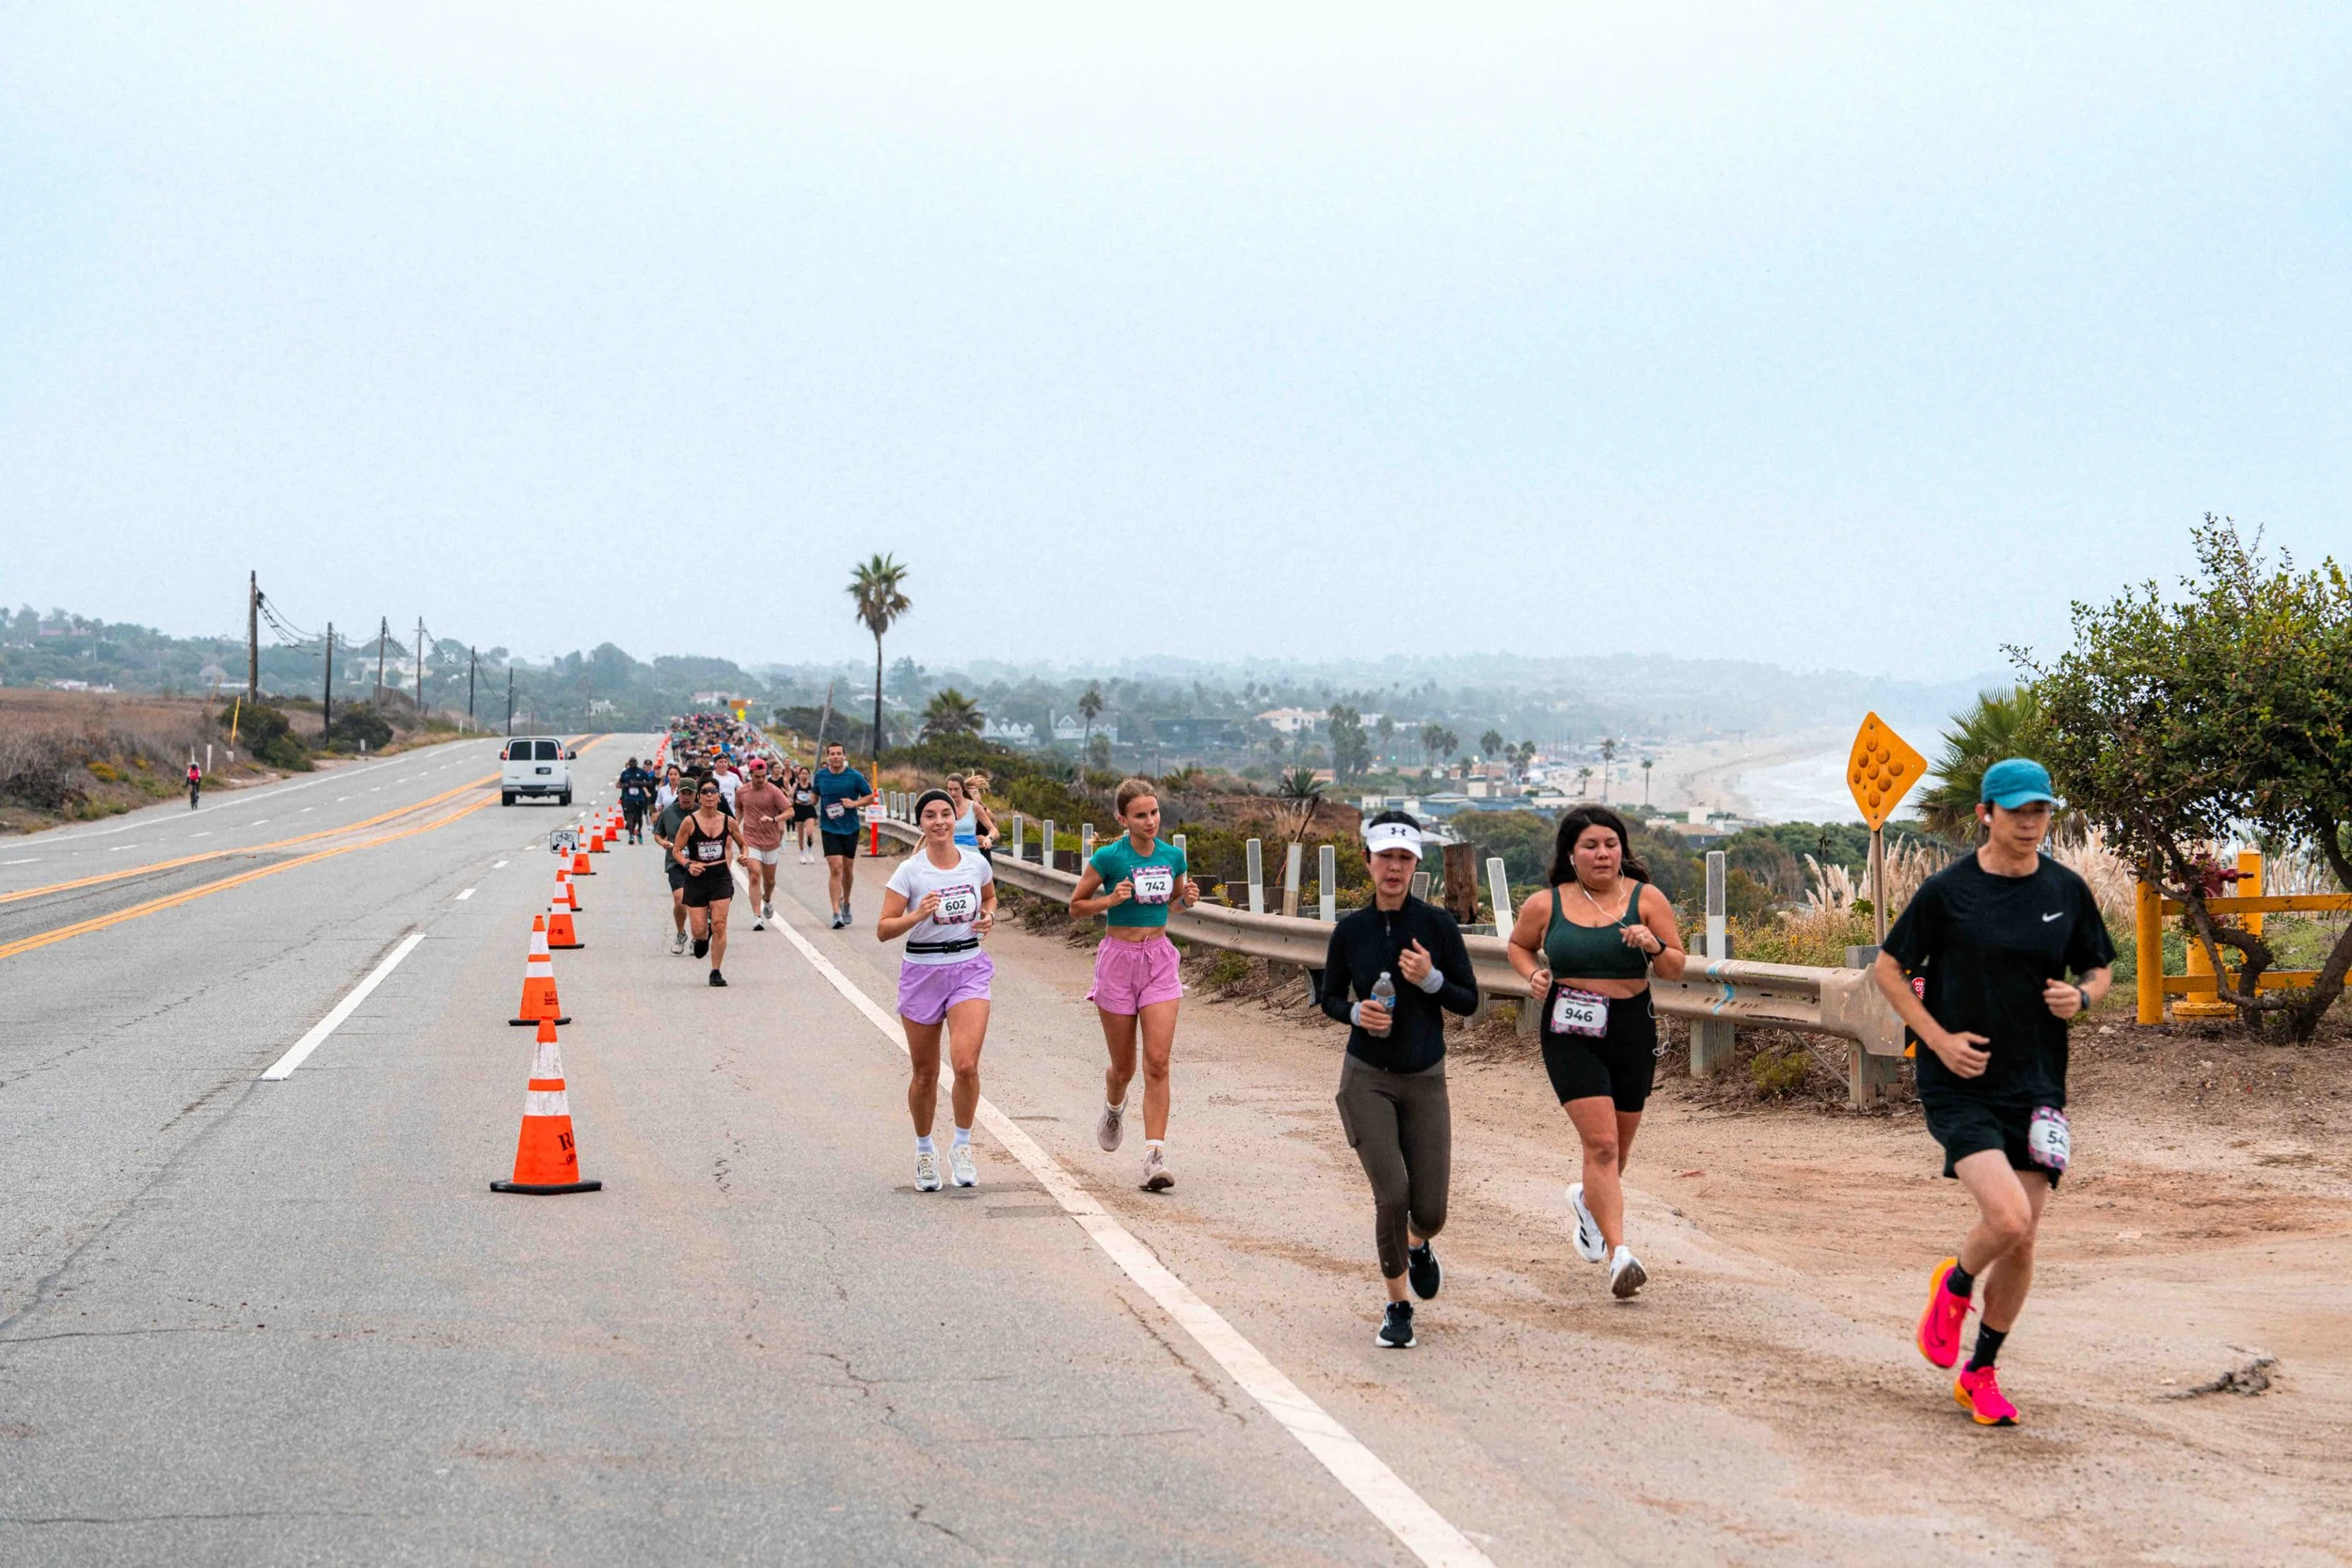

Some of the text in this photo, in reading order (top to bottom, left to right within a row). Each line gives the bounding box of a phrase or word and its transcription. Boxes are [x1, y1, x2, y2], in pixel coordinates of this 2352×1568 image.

[1145, 880, 1166, 892] 742
[946, 899, 966, 911] 602
[1565, 1007, 1594, 1022] 946
